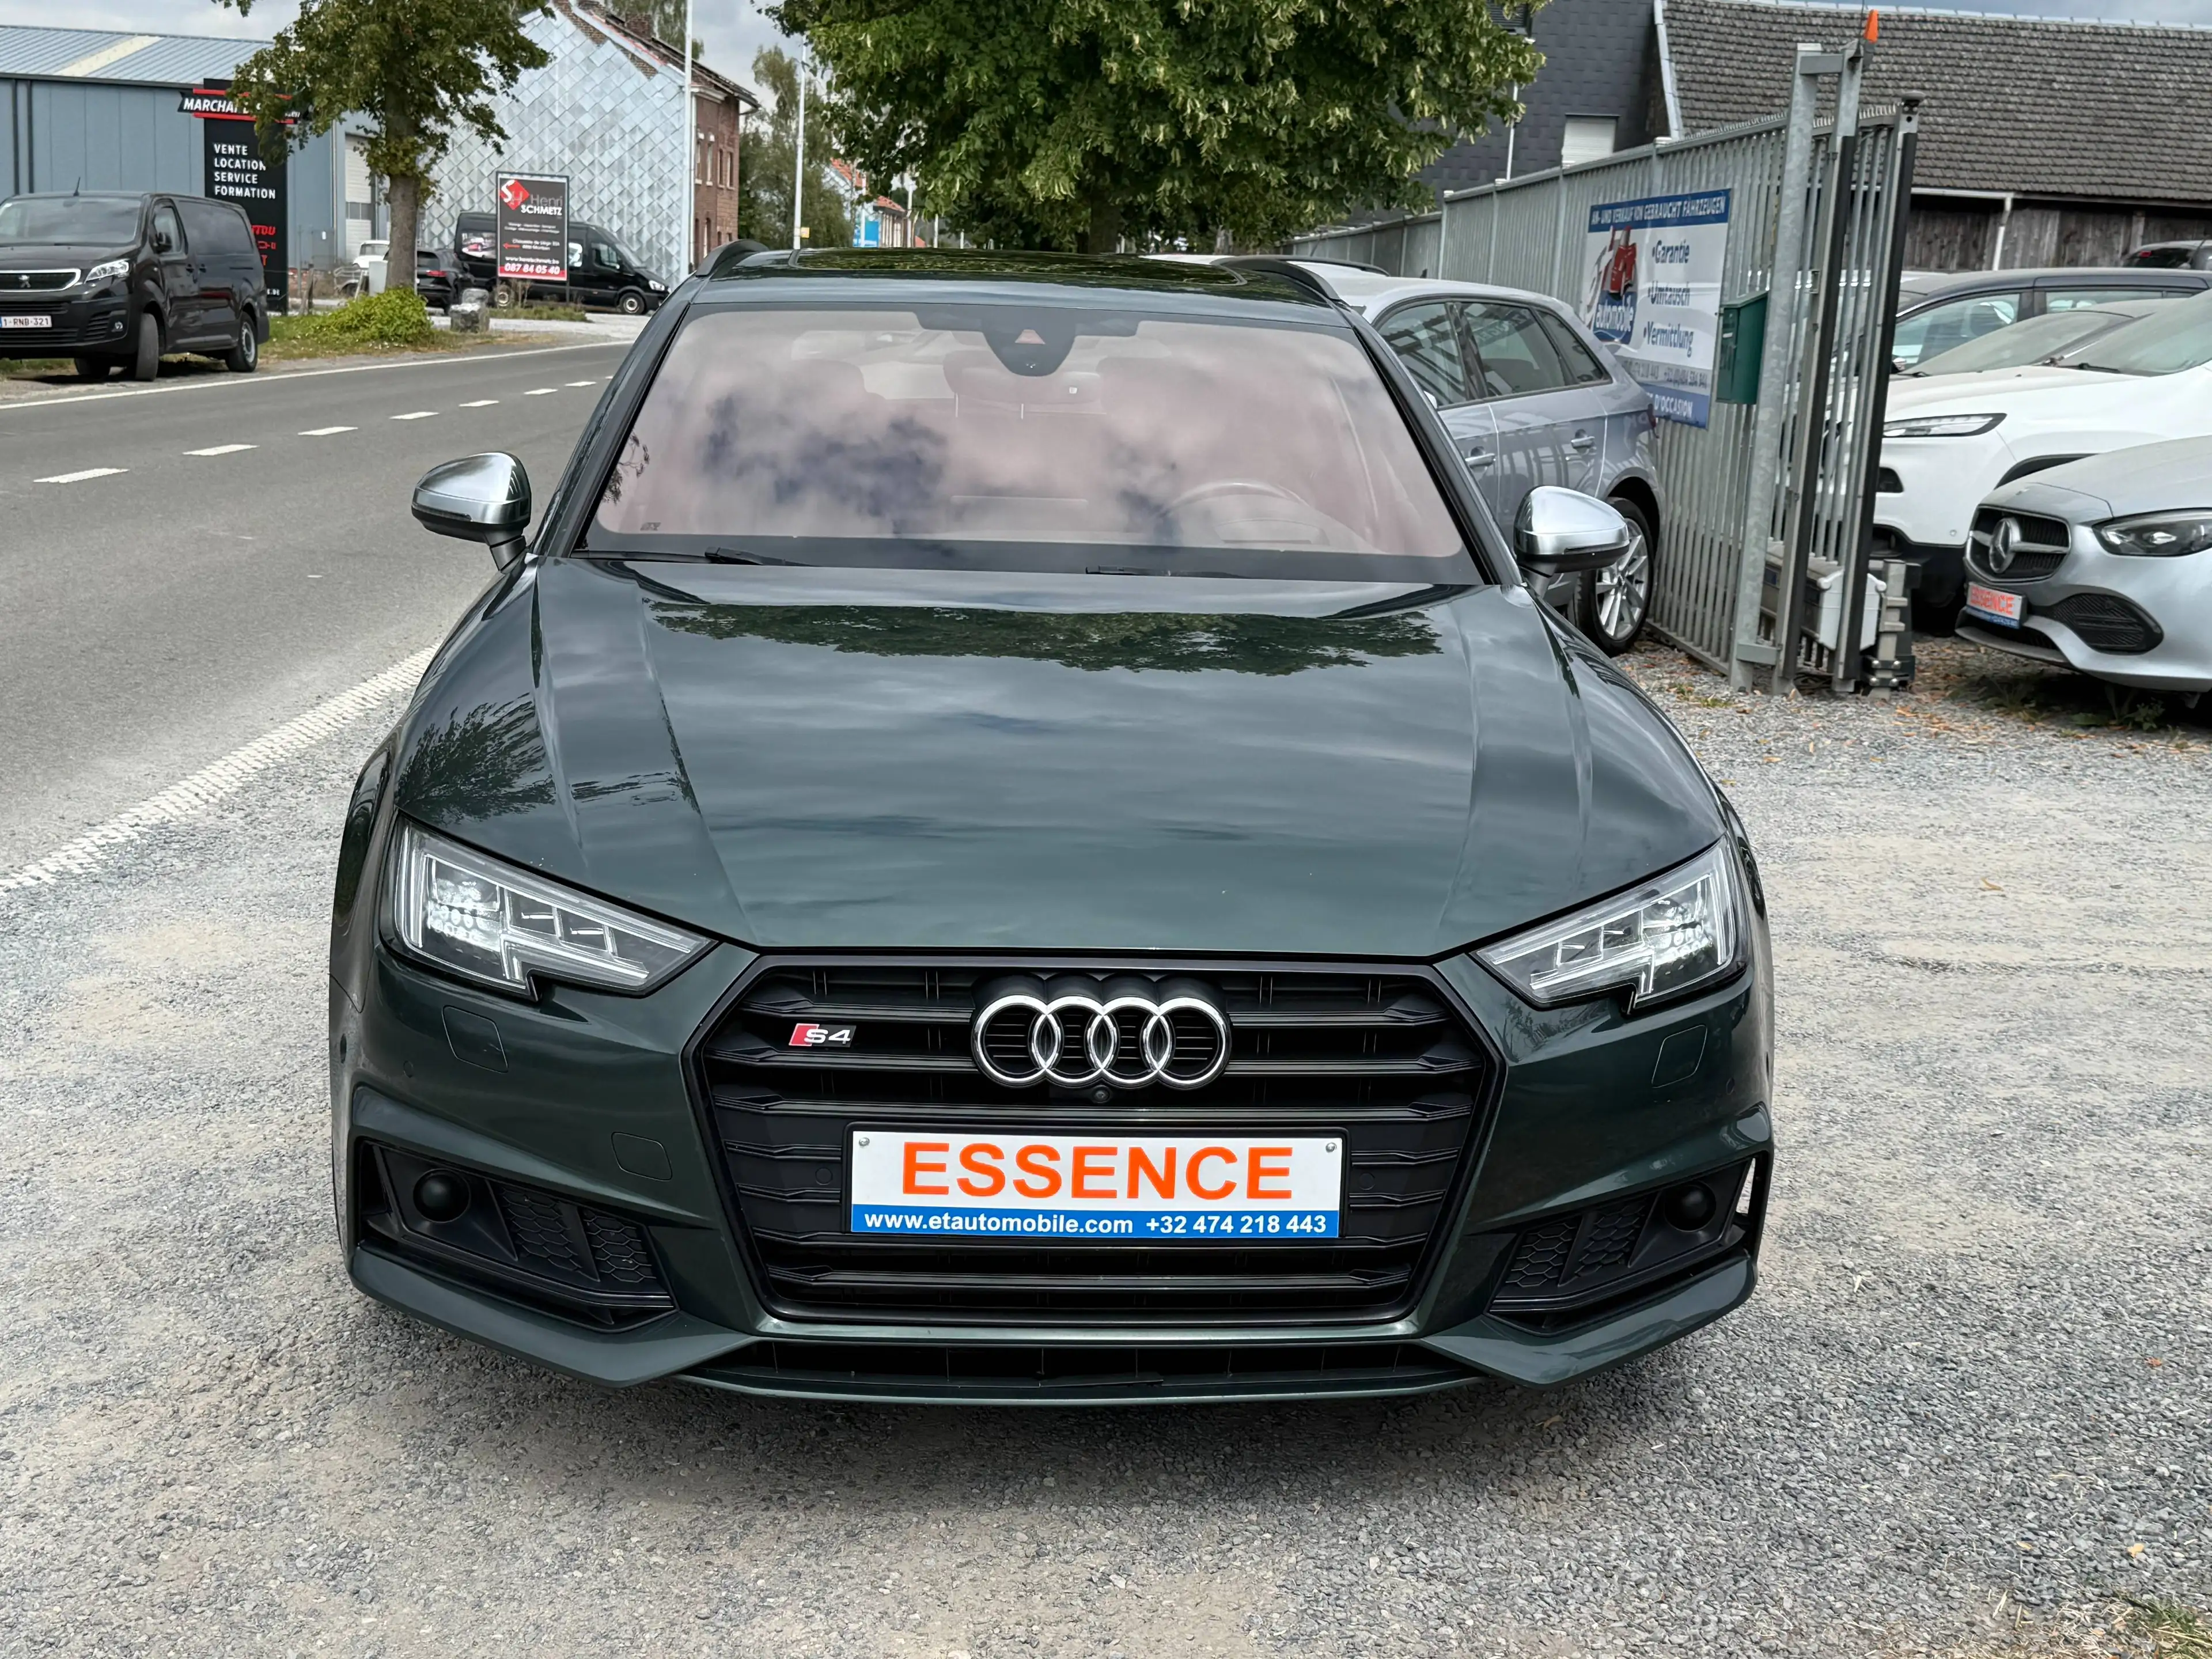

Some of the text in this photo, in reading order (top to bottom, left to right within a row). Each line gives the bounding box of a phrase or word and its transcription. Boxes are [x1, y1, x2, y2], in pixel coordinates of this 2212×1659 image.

[214, 144, 248, 156] VENTE
[214, 158, 266, 171] LOCATION
[214, 172, 258, 184] SERVICE
[215, 185, 275, 199] FORMATION
[531, 194, 563, 207] Henri
[521, 204, 562, 215] SCHMETZ
[1644, 201, 1682, 220] GEBRAUCHT
[1682, 196, 1726, 217] FAHRZEUGEN
[505, 262, 560, 275] 087 84 05 40
[1654, 394, 1693, 418] D'OCCASION
[804, 1029, 851, 1044] S4
[903, 1141, 1293, 1200] ESSENCE
[864, 1212, 1326, 1234] www.etautomobile.com +32 474 218 443
